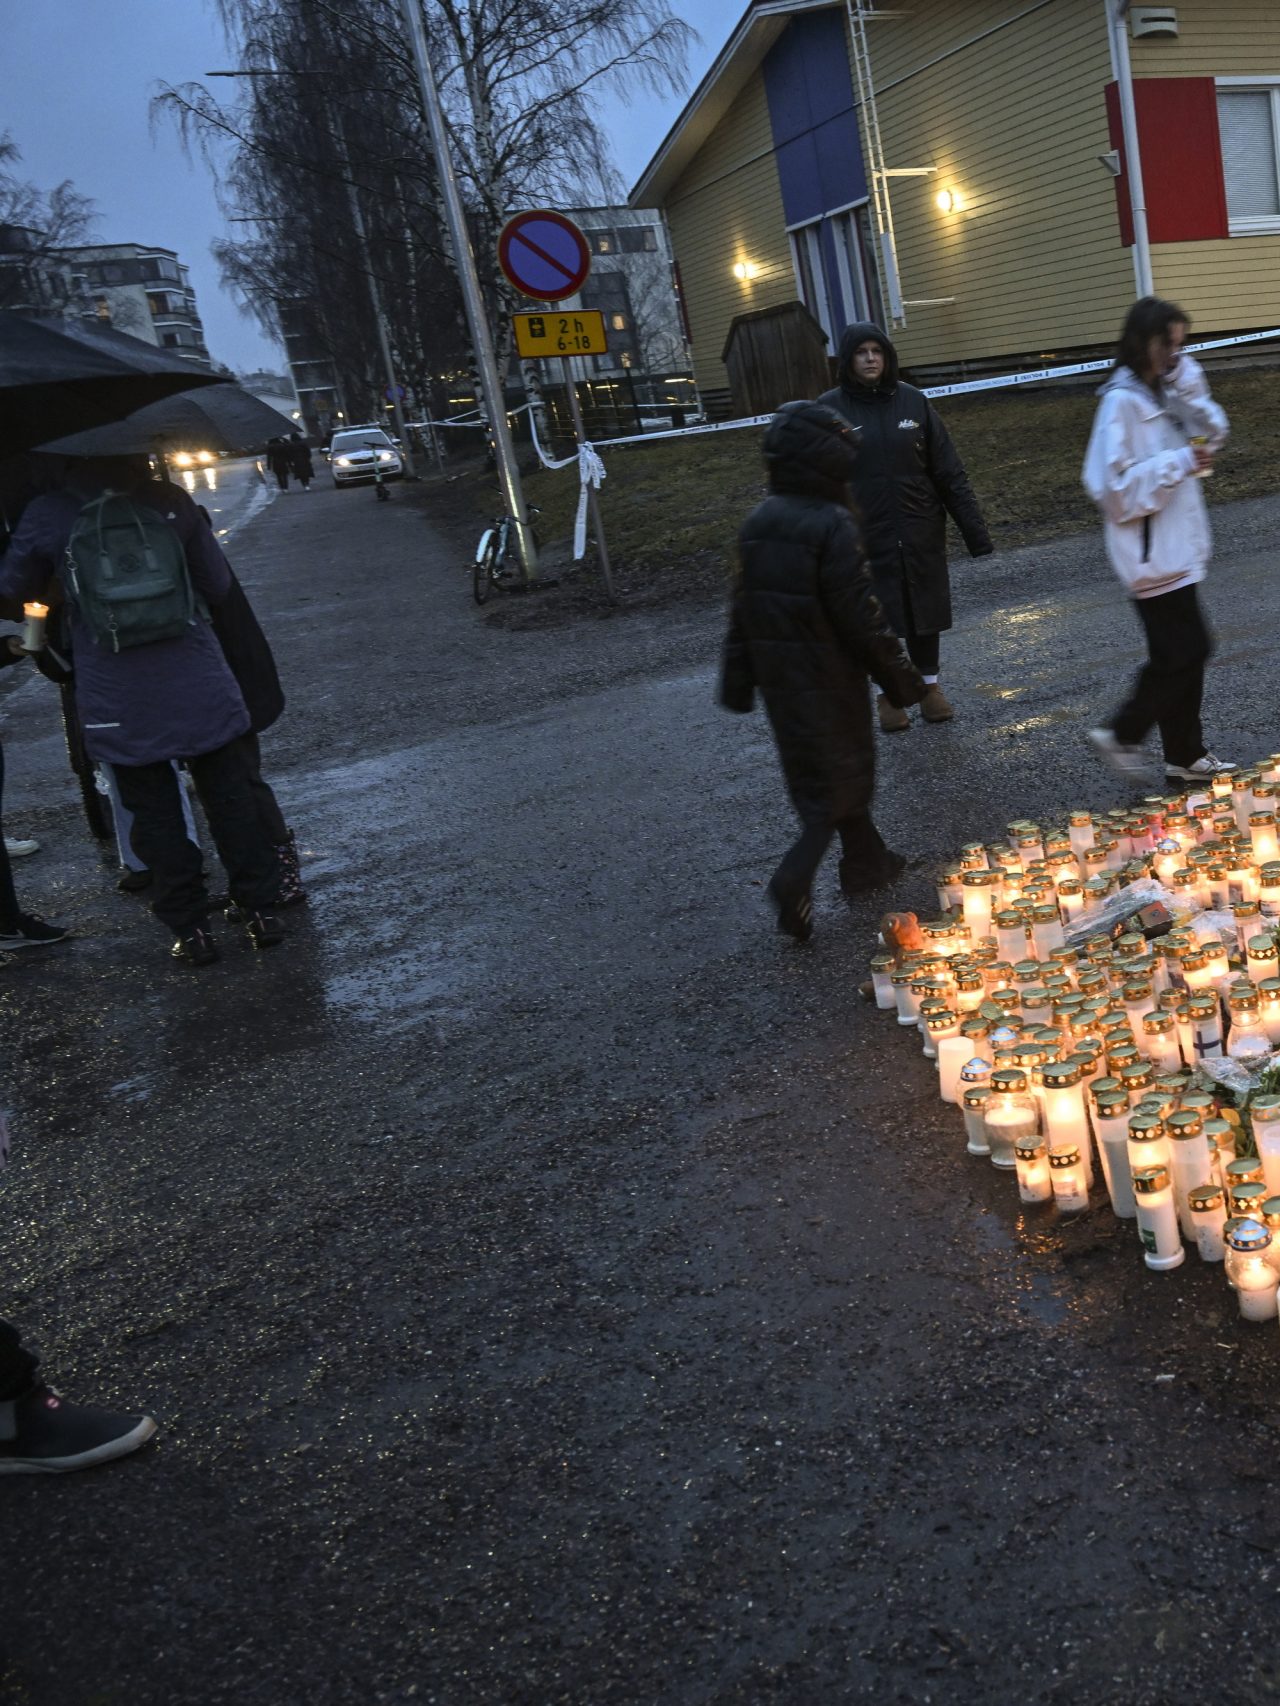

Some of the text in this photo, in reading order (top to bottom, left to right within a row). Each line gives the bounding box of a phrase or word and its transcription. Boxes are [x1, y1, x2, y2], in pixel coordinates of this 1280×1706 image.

[559, 318, 584, 334] 2 h
[557, 335, 590, 350] 6-18
[927, 388, 946, 396] POLIS
